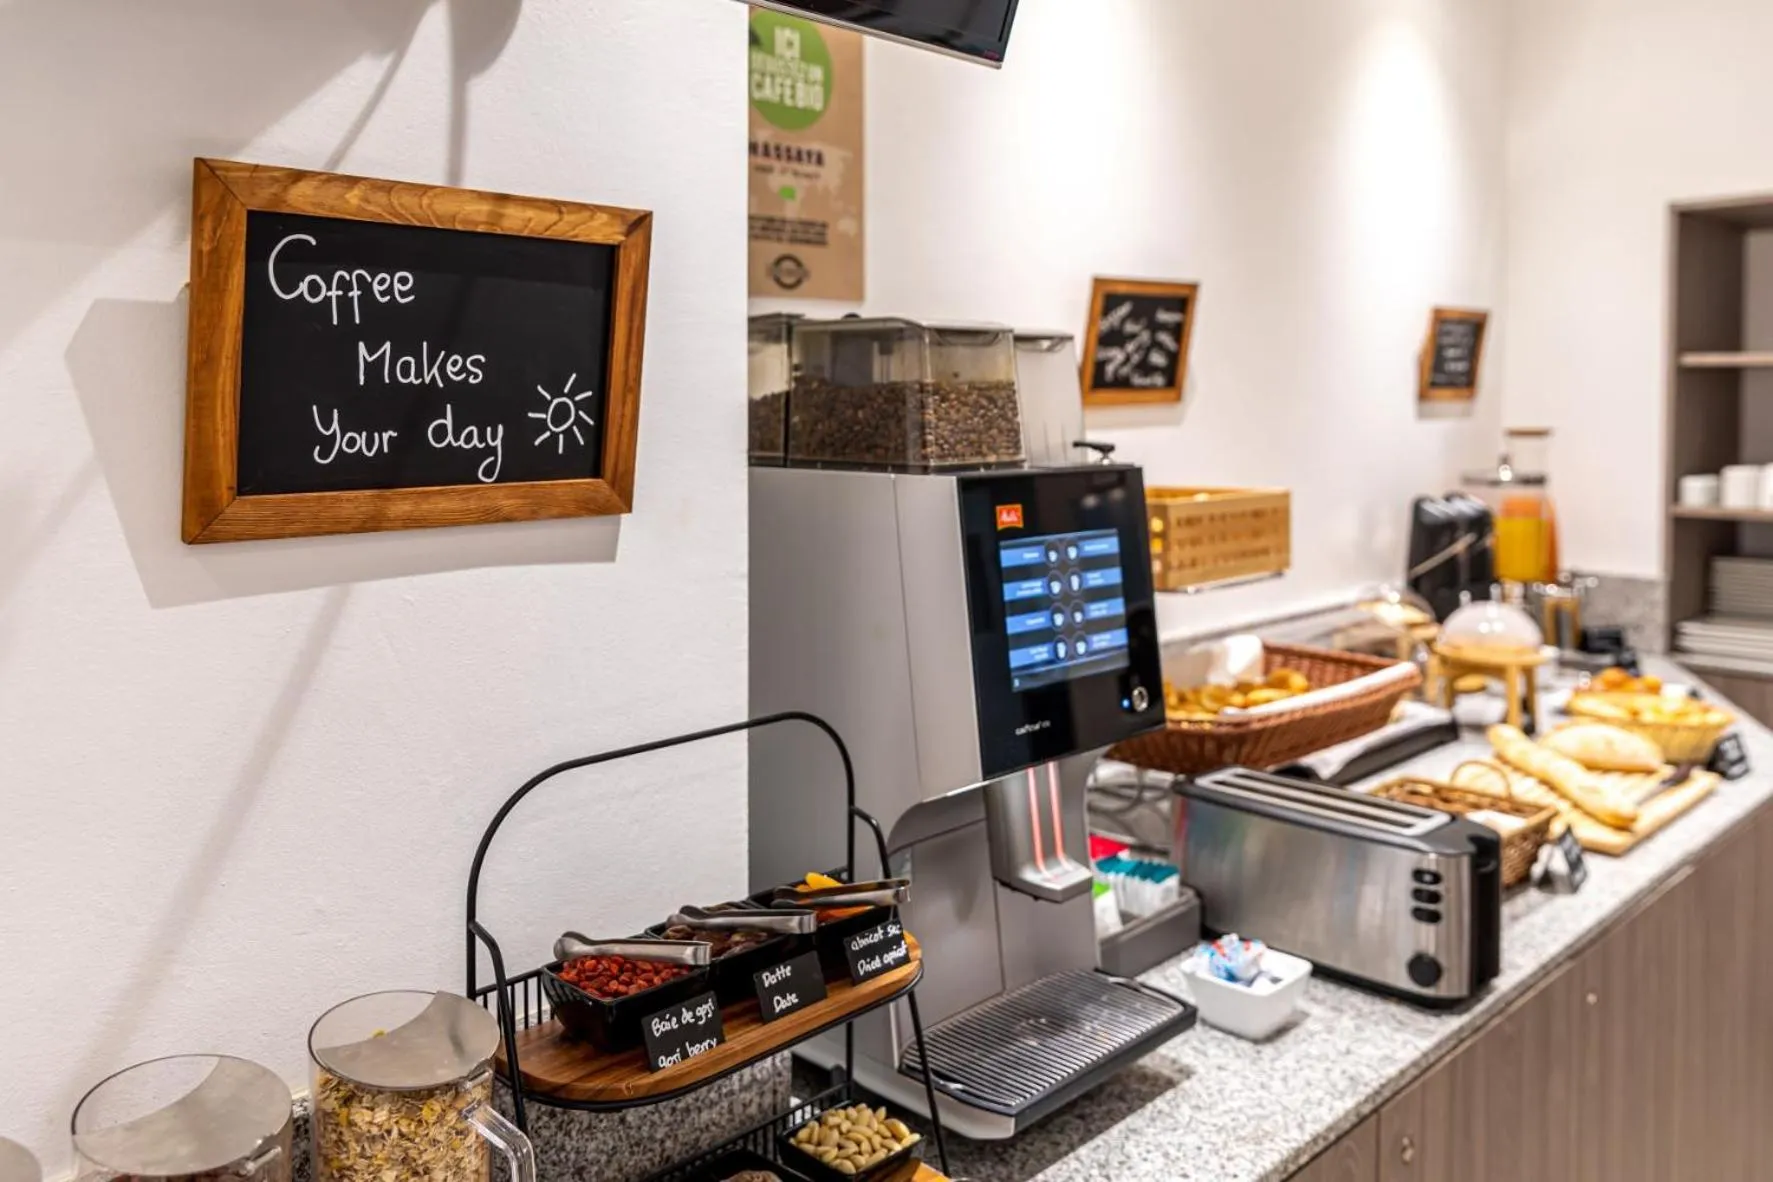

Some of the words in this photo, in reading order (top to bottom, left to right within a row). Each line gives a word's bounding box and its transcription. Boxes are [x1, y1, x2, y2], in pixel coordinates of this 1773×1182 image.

[268, 234, 415, 325] Coffee
[357, 340, 485, 388] Makes
[312, 404, 397, 464] Your
[427, 403, 504, 483] day
[651, 1013, 679, 1037] Baie
[773, 992, 799, 1013] Date
